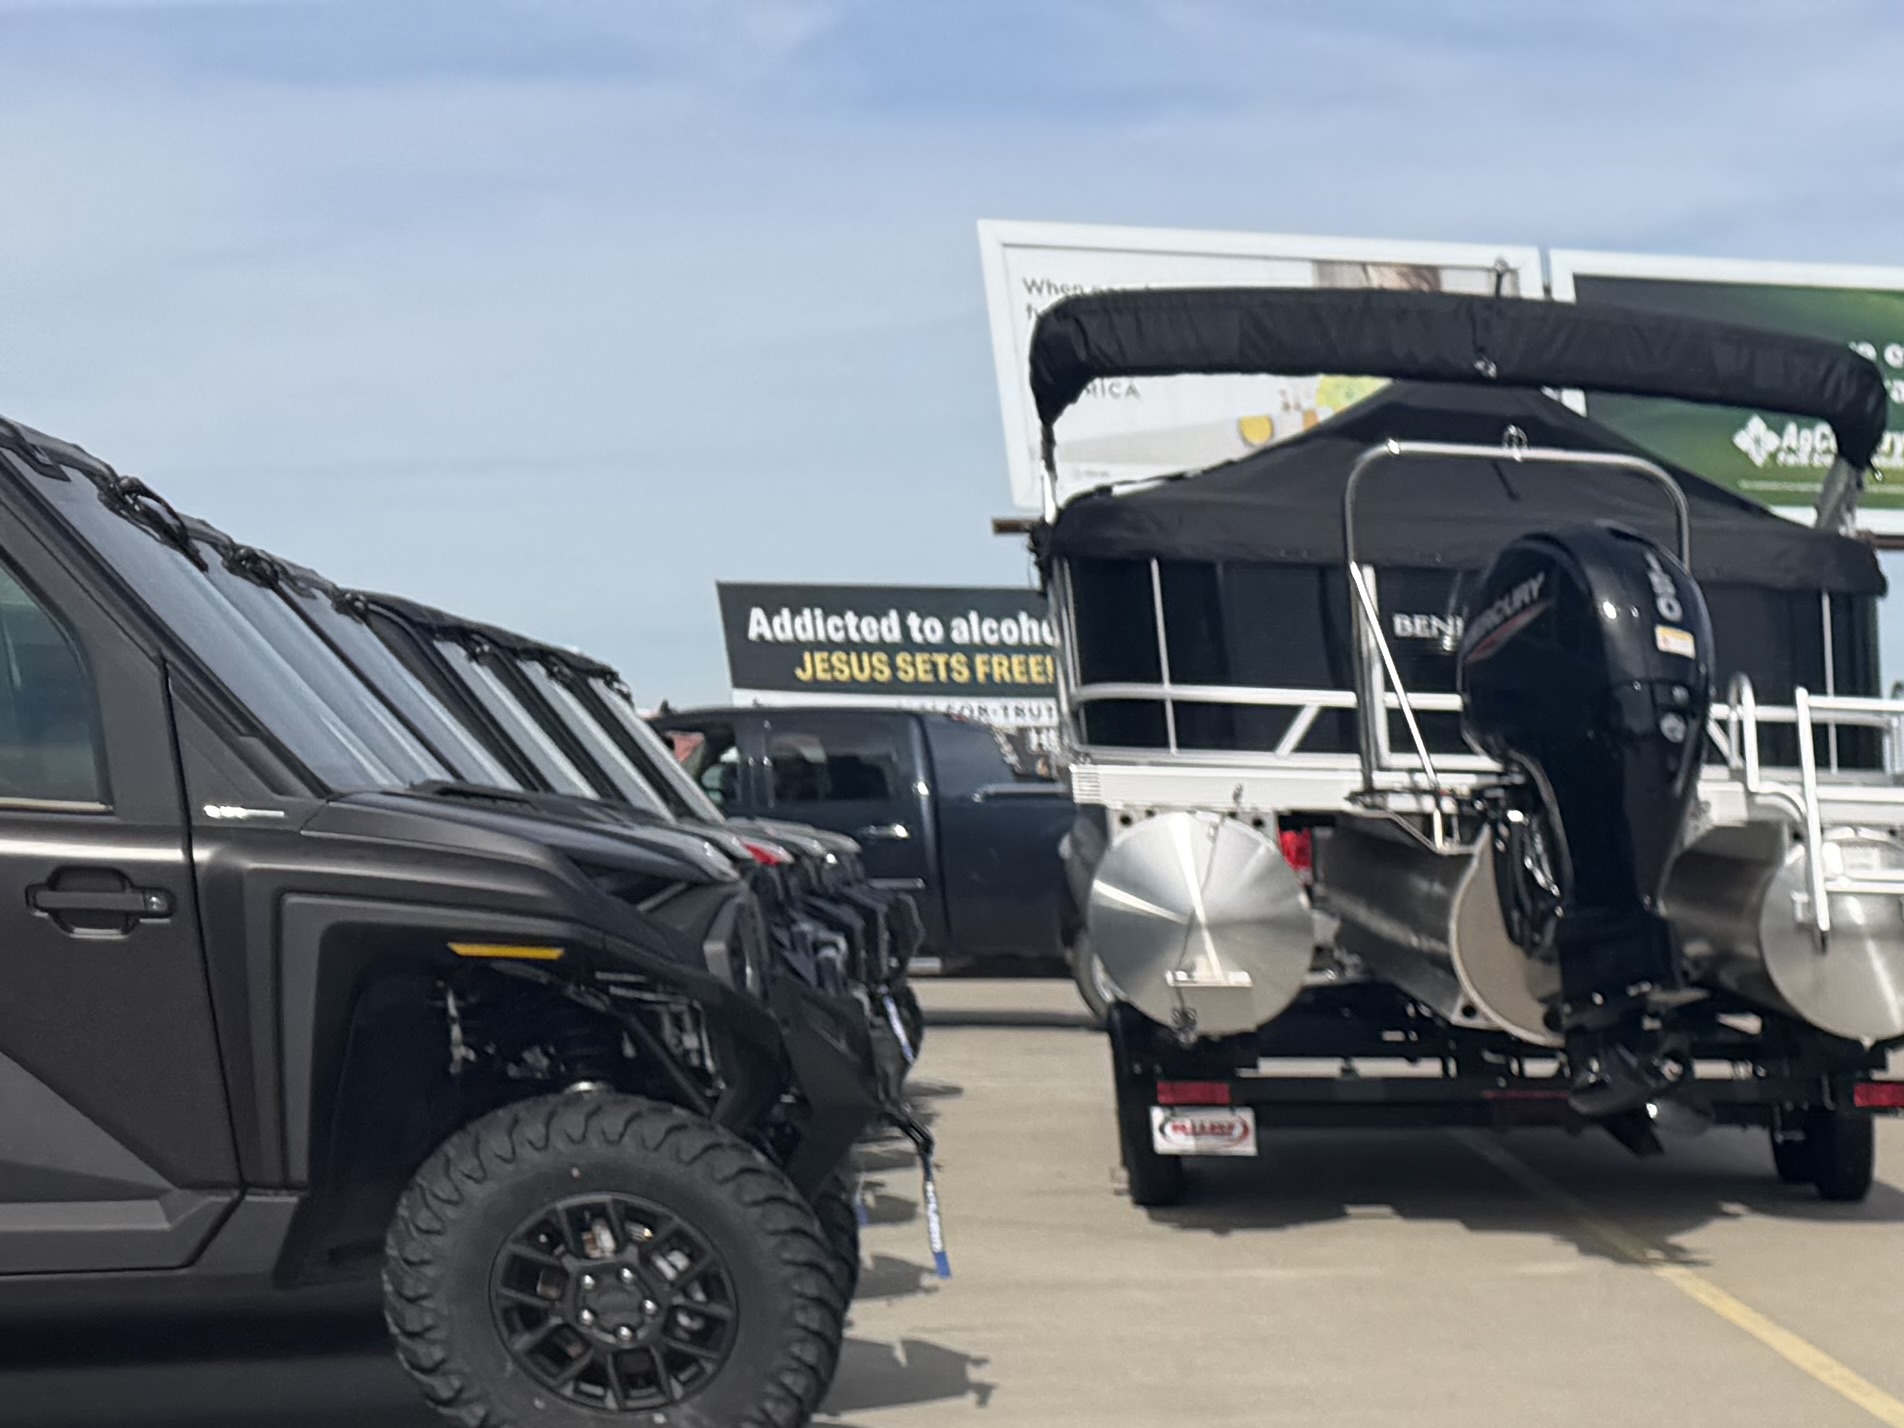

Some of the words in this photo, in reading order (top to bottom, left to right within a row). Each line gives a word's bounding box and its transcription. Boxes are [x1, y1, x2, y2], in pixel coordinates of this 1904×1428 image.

[748, 606, 902, 643] Addicted
[907, 611, 945, 644] to
[795, 651, 893, 682] JESUS
[896, 652, 971, 683] SETS
[975, 653, 1055, 684] FREE!
